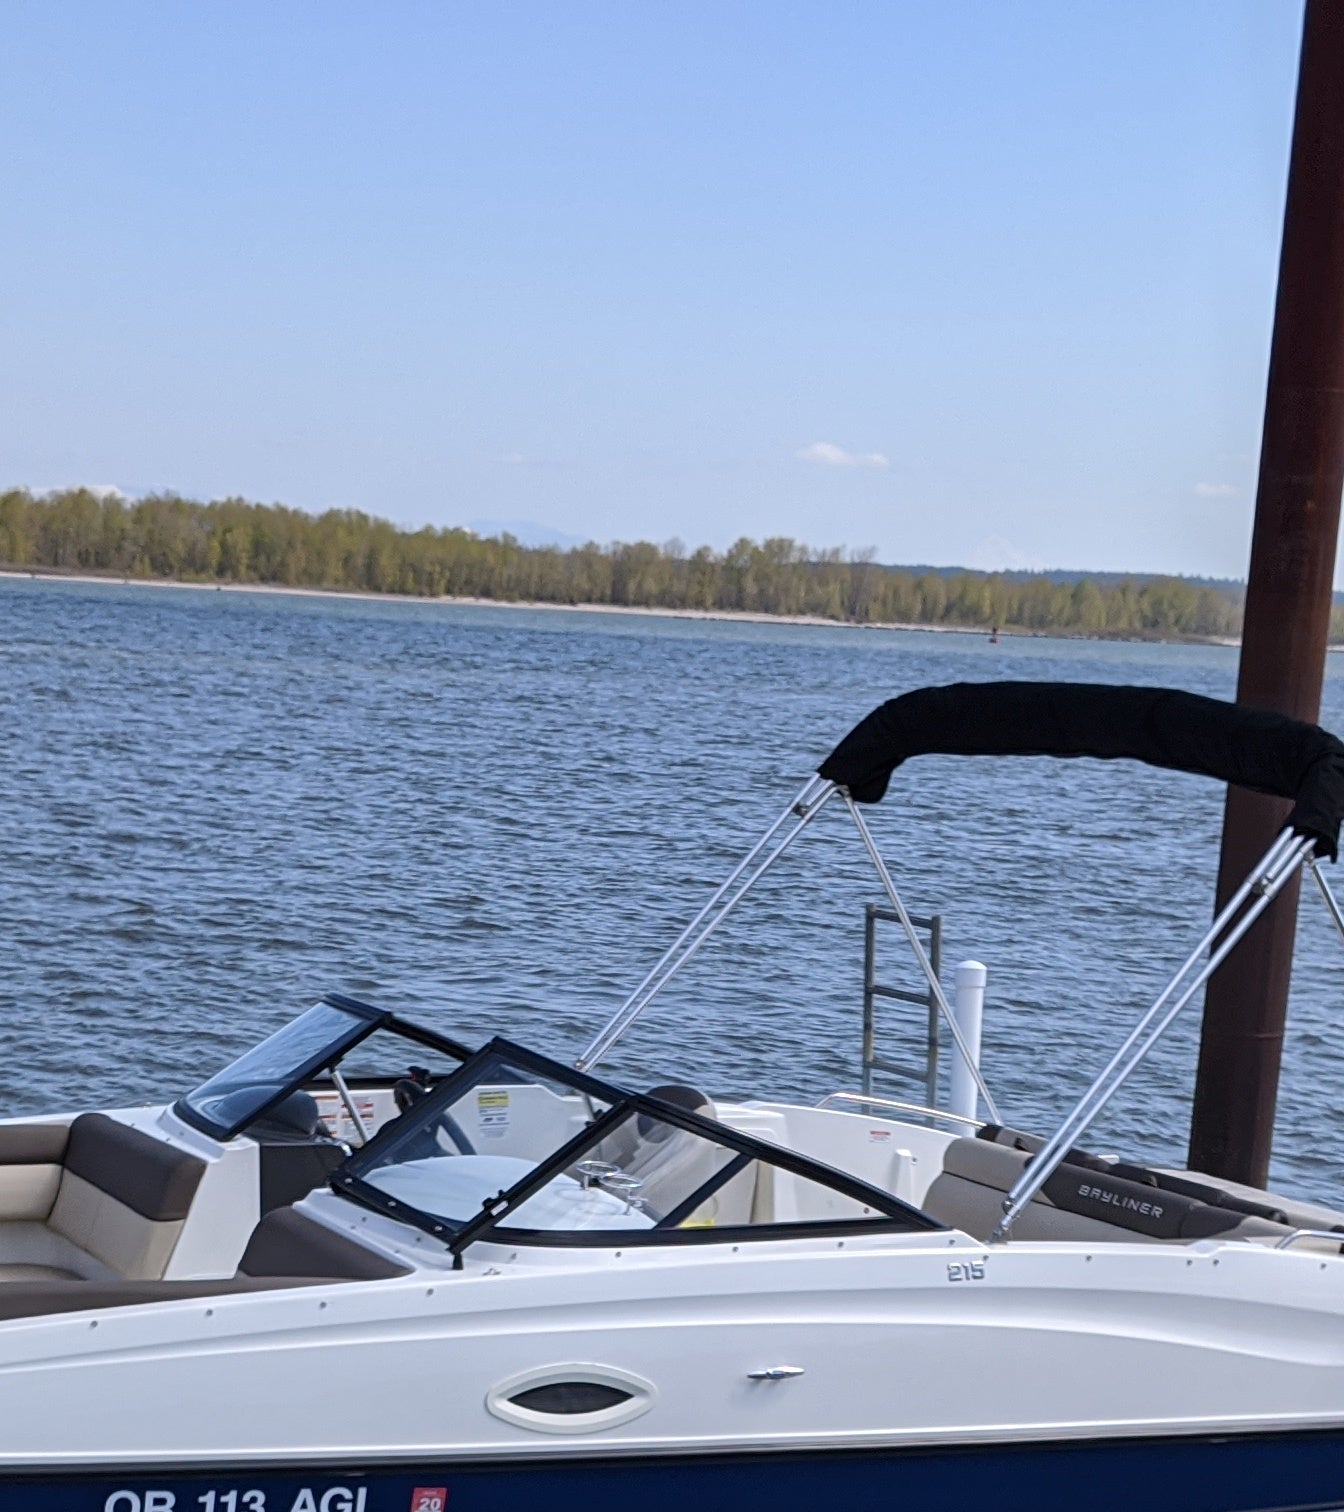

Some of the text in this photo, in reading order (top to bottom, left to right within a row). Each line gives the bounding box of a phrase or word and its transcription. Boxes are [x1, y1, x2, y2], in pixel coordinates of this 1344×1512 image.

[1077, 1184, 1164, 1219] BAYLINER
[946, 1261, 985, 1282] 215
[418, 1497, 442, 1512] 20
